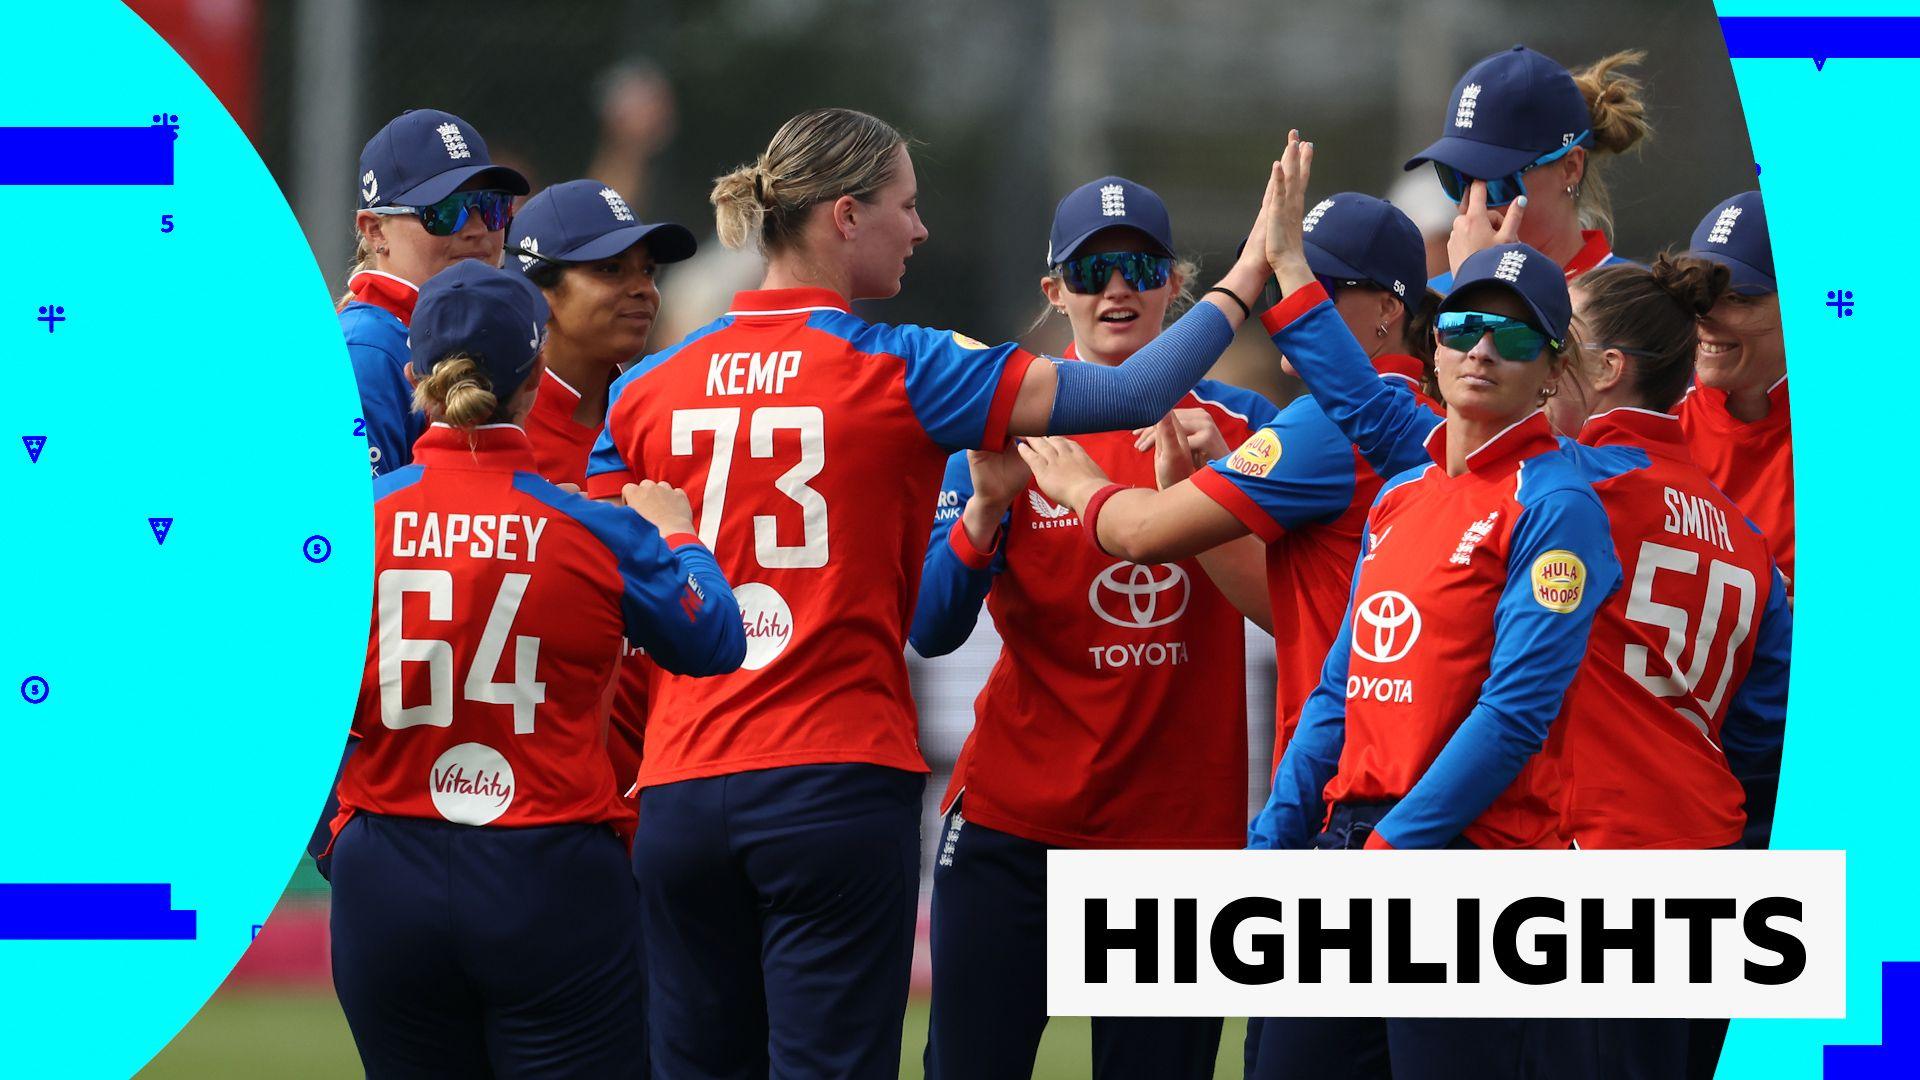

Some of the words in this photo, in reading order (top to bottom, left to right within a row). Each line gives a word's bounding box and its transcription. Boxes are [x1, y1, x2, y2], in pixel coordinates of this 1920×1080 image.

[1562, 133, 1574, 147] 57
[363, 170, 374, 186] 100
[1393, 280, 1405, 296] 58
[706, 351, 802, 396] KEMP
[1232, 455, 1266, 475] HOOPS
[671, 406, 829, 569] 73
[935, 508, 960, 520] ANK
[1032, 518, 1078, 529] CASTORE
[1664, 486, 1734, 552] SMITH
[393, 511, 548, 562] CAPSEY
[1542, 563, 1577, 580] HULA
[1539, 585, 1579, 603] HOOPS
[741, 609, 789, 647] ality
[1624, 541, 1756, 719] 50
[378, 569, 546, 734] 64
[1088, 641, 1188, 669] TOYOTA
[1346, 675, 1413, 703] OYOTA
[434, 763, 511, 807] Vitality
